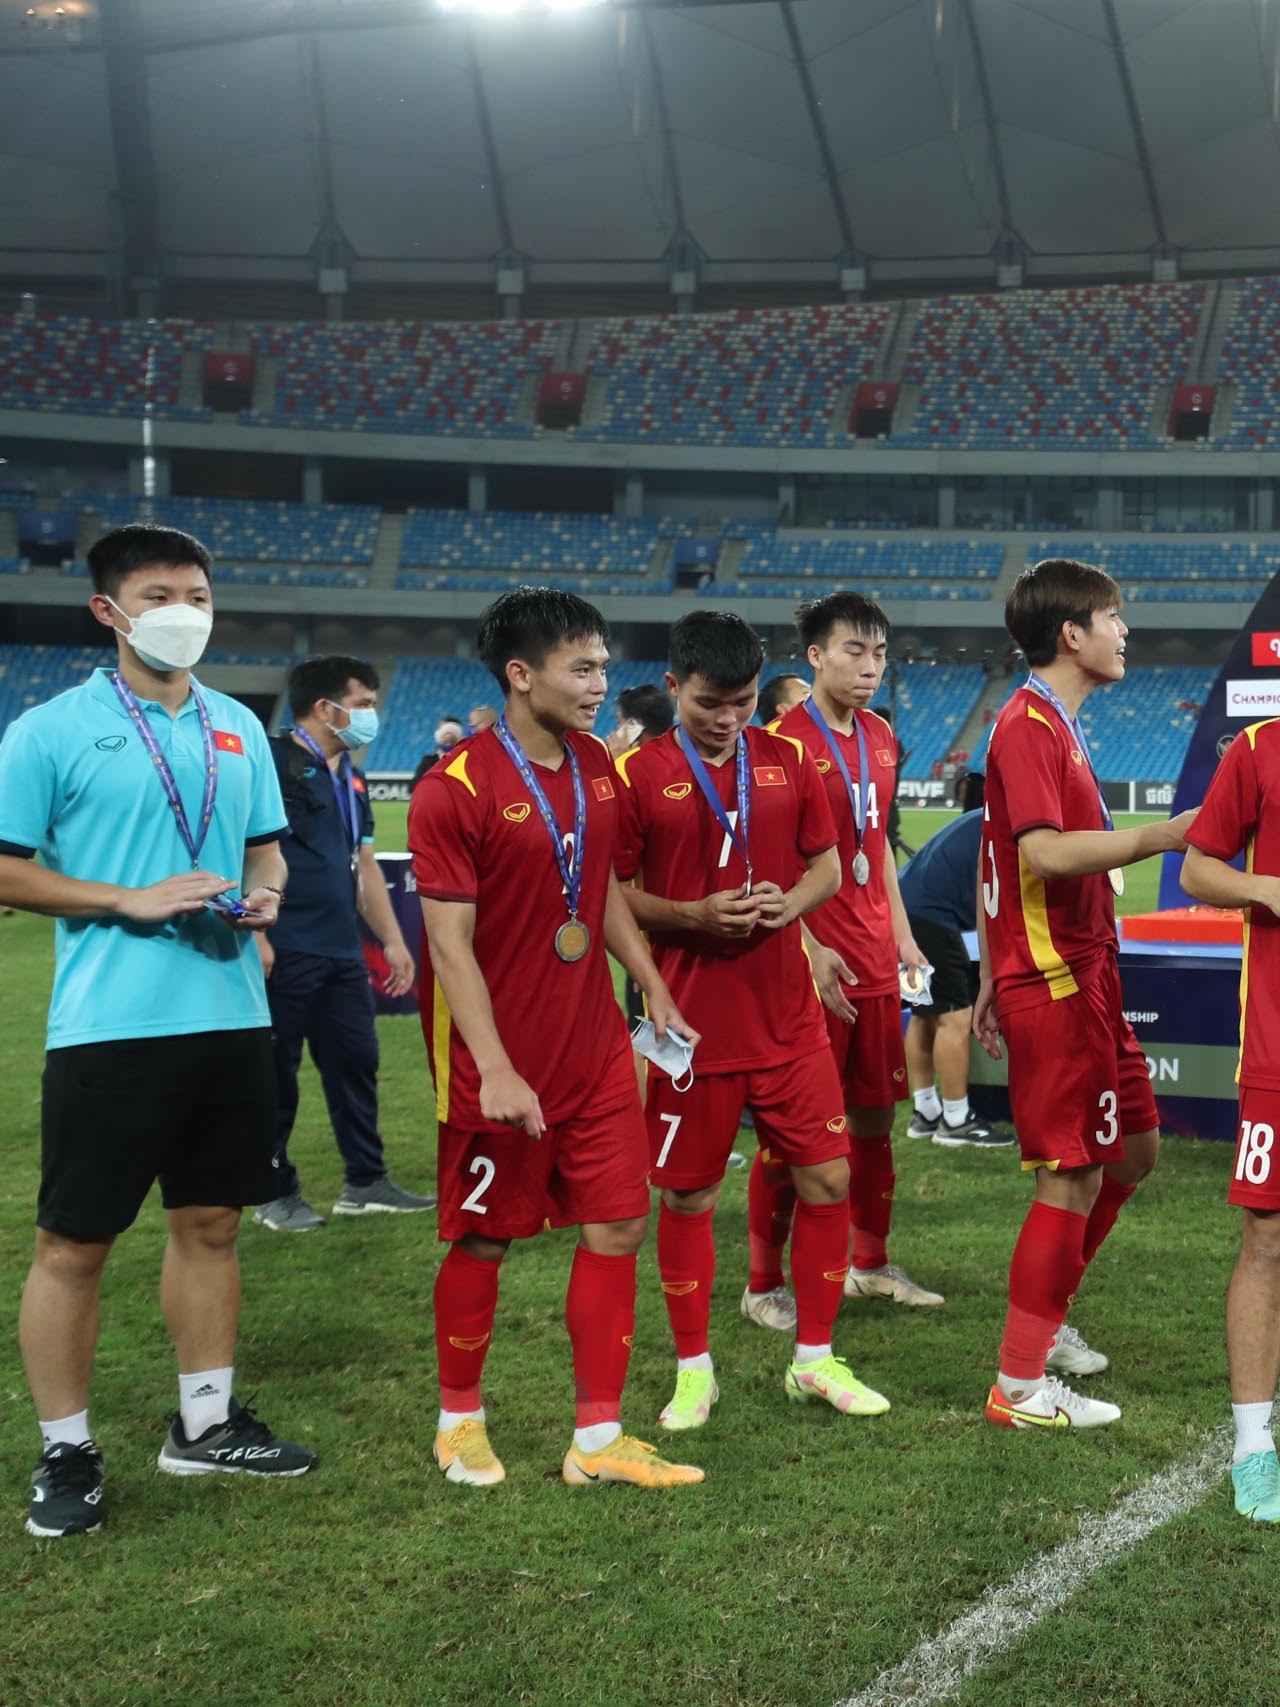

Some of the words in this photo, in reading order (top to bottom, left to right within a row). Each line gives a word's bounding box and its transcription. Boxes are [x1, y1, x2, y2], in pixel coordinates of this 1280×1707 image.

[656, 1112, 682, 1169] 7
[1095, 1090, 1118, 1146] 3
[1235, 1120, 1274, 1185] 18
[460, 1155, 496, 1215] 2
